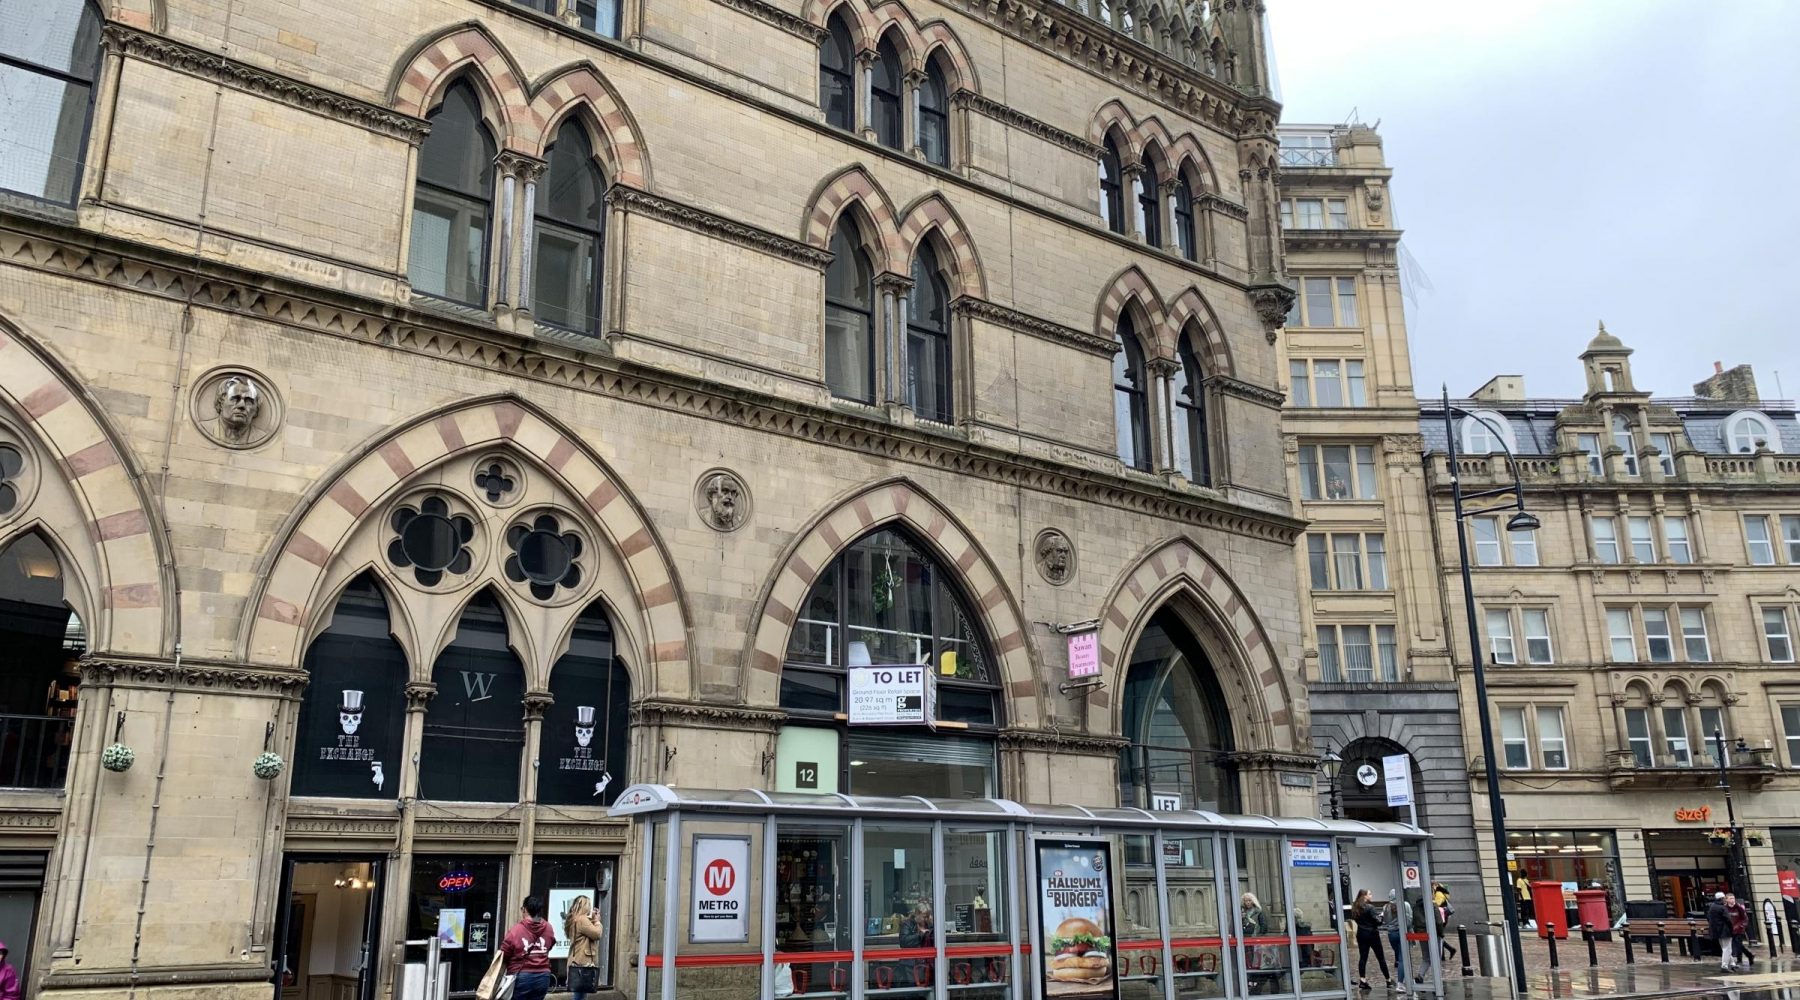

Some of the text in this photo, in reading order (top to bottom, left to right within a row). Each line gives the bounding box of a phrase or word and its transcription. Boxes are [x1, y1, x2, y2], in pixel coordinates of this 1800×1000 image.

[459, 670, 498, 699] W
[872, 671, 921, 684] TO LET
[338, 734, 360, 748] THE
[319, 747, 375, 761] EXCHANGE
[573, 746, 593, 759] THE
[559, 757, 605, 771] EXCHANGE
[799, 768, 815, 782] 12
[1675, 805, 1711, 822] size?
[439, 876, 474, 889] OPEN
[708, 866, 732, 889] M
[1047, 877, 1102, 889] HALLOUMI
[698, 900, 739, 911] METRO
[1053, 891, 1098, 908] BURGER
